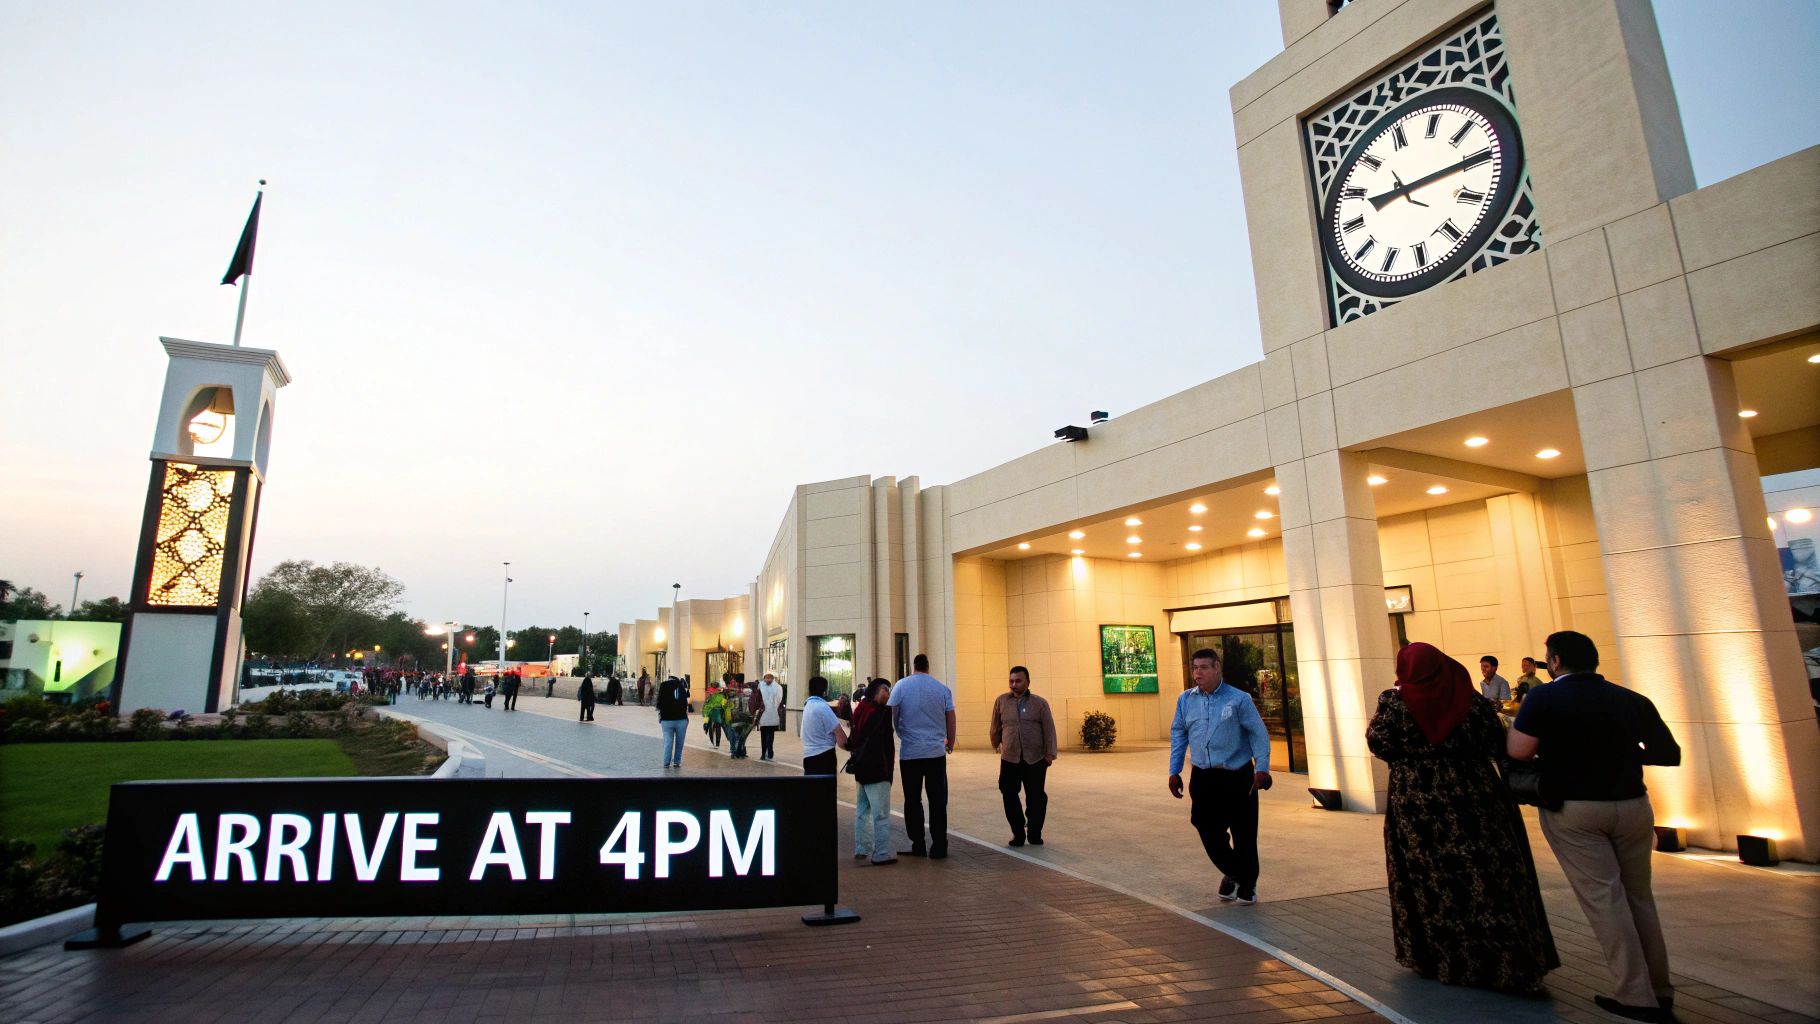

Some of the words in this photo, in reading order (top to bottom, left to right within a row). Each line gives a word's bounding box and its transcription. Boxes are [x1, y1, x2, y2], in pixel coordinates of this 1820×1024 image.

[154, 812, 440, 882] ARRIVE
[469, 811, 572, 881] AT
[599, 809, 776, 880] 4PM
